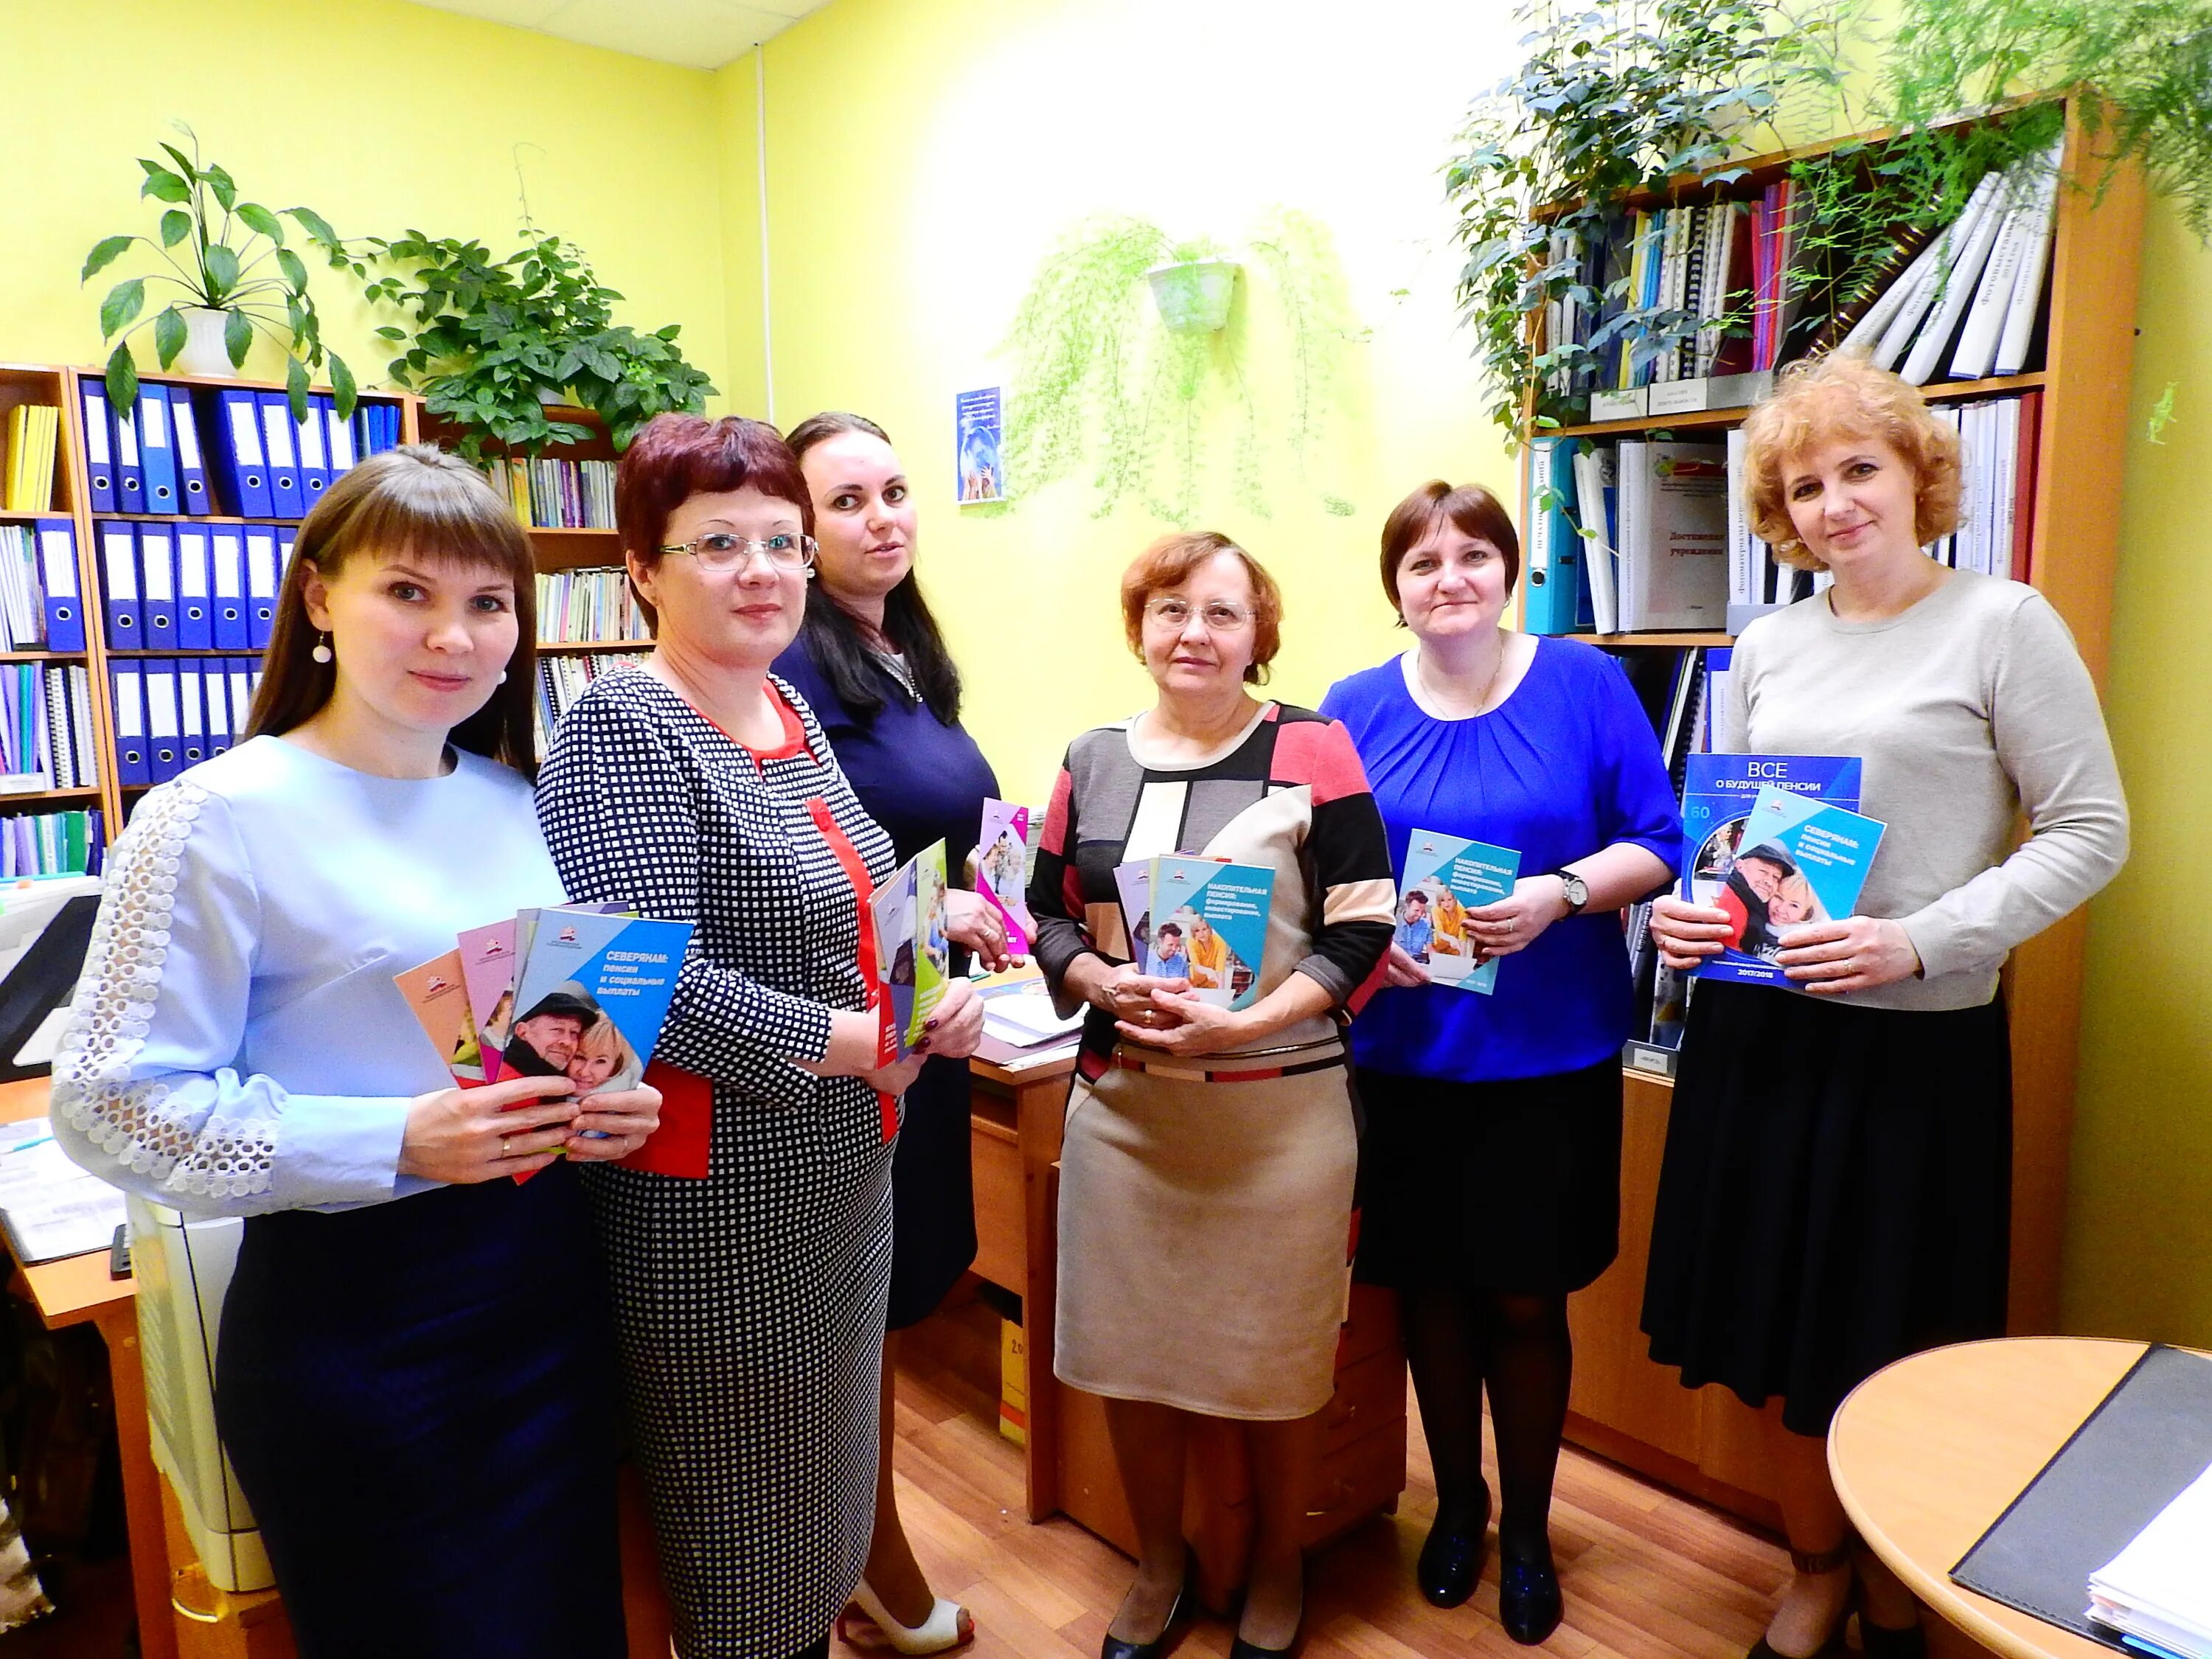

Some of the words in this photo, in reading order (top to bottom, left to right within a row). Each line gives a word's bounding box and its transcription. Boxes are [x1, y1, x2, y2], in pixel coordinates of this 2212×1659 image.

[1747, 762, 1788, 779] ВСЕ
[1716, 781, 1725, 789] О
[1776, 782, 1821, 792] ПЕНСИИ
[1691, 806, 1711, 819] 60
[605, 950, 669, 964] СЕВЕРЯНАМ:
[602, 964, 639, 973] пенсии
[609, 976, 666, 986] социальные
[597, 987, 641, 996] выплаты
